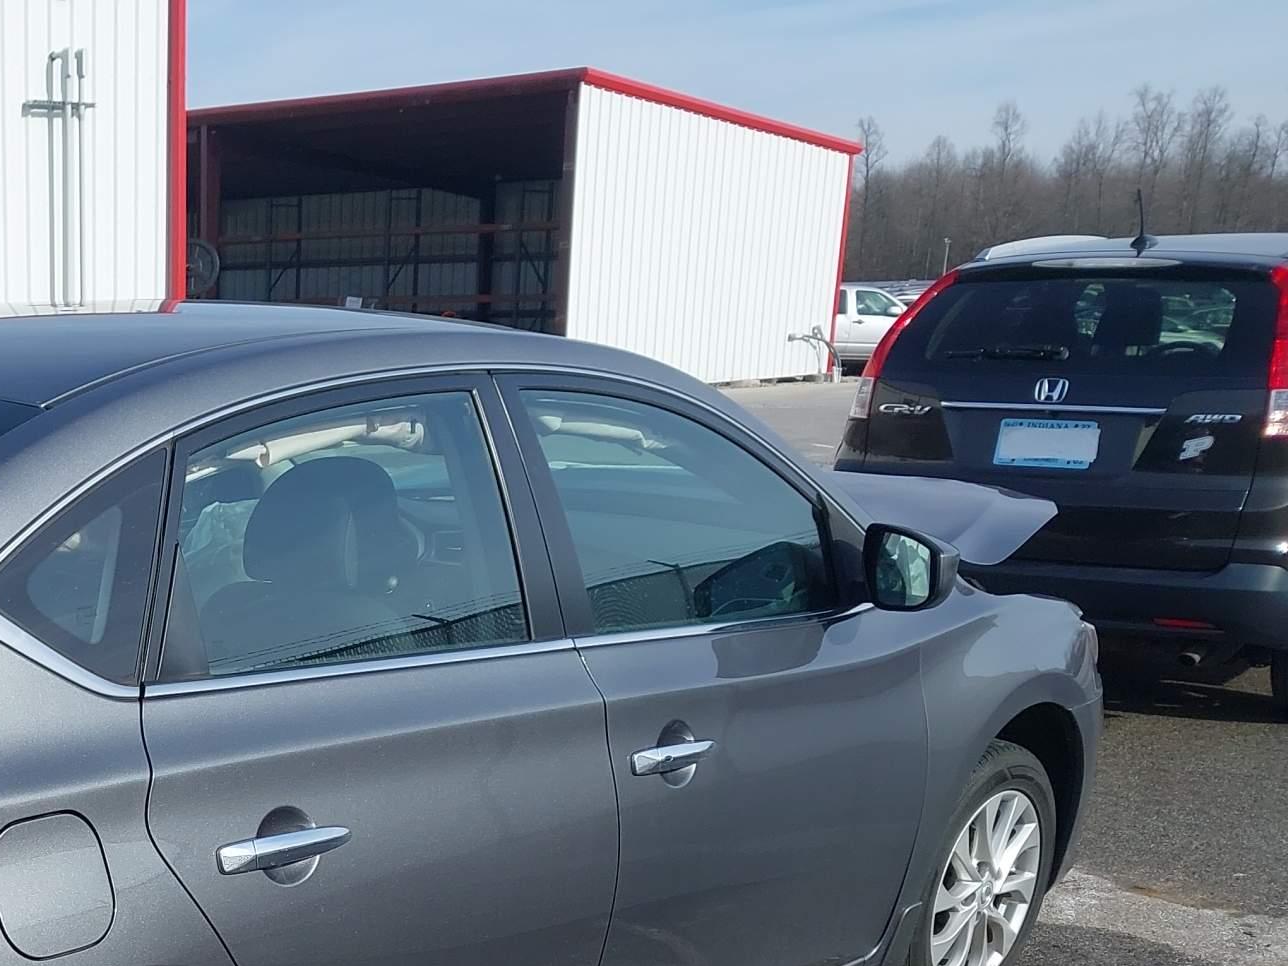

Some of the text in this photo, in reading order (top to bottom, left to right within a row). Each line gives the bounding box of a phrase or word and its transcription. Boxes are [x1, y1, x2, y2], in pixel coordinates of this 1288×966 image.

[878, 403, 932, 415] CR-V
[1184, 413, 1243, 424] AWD
[1026, 421, 1070, 430] INDIANA
